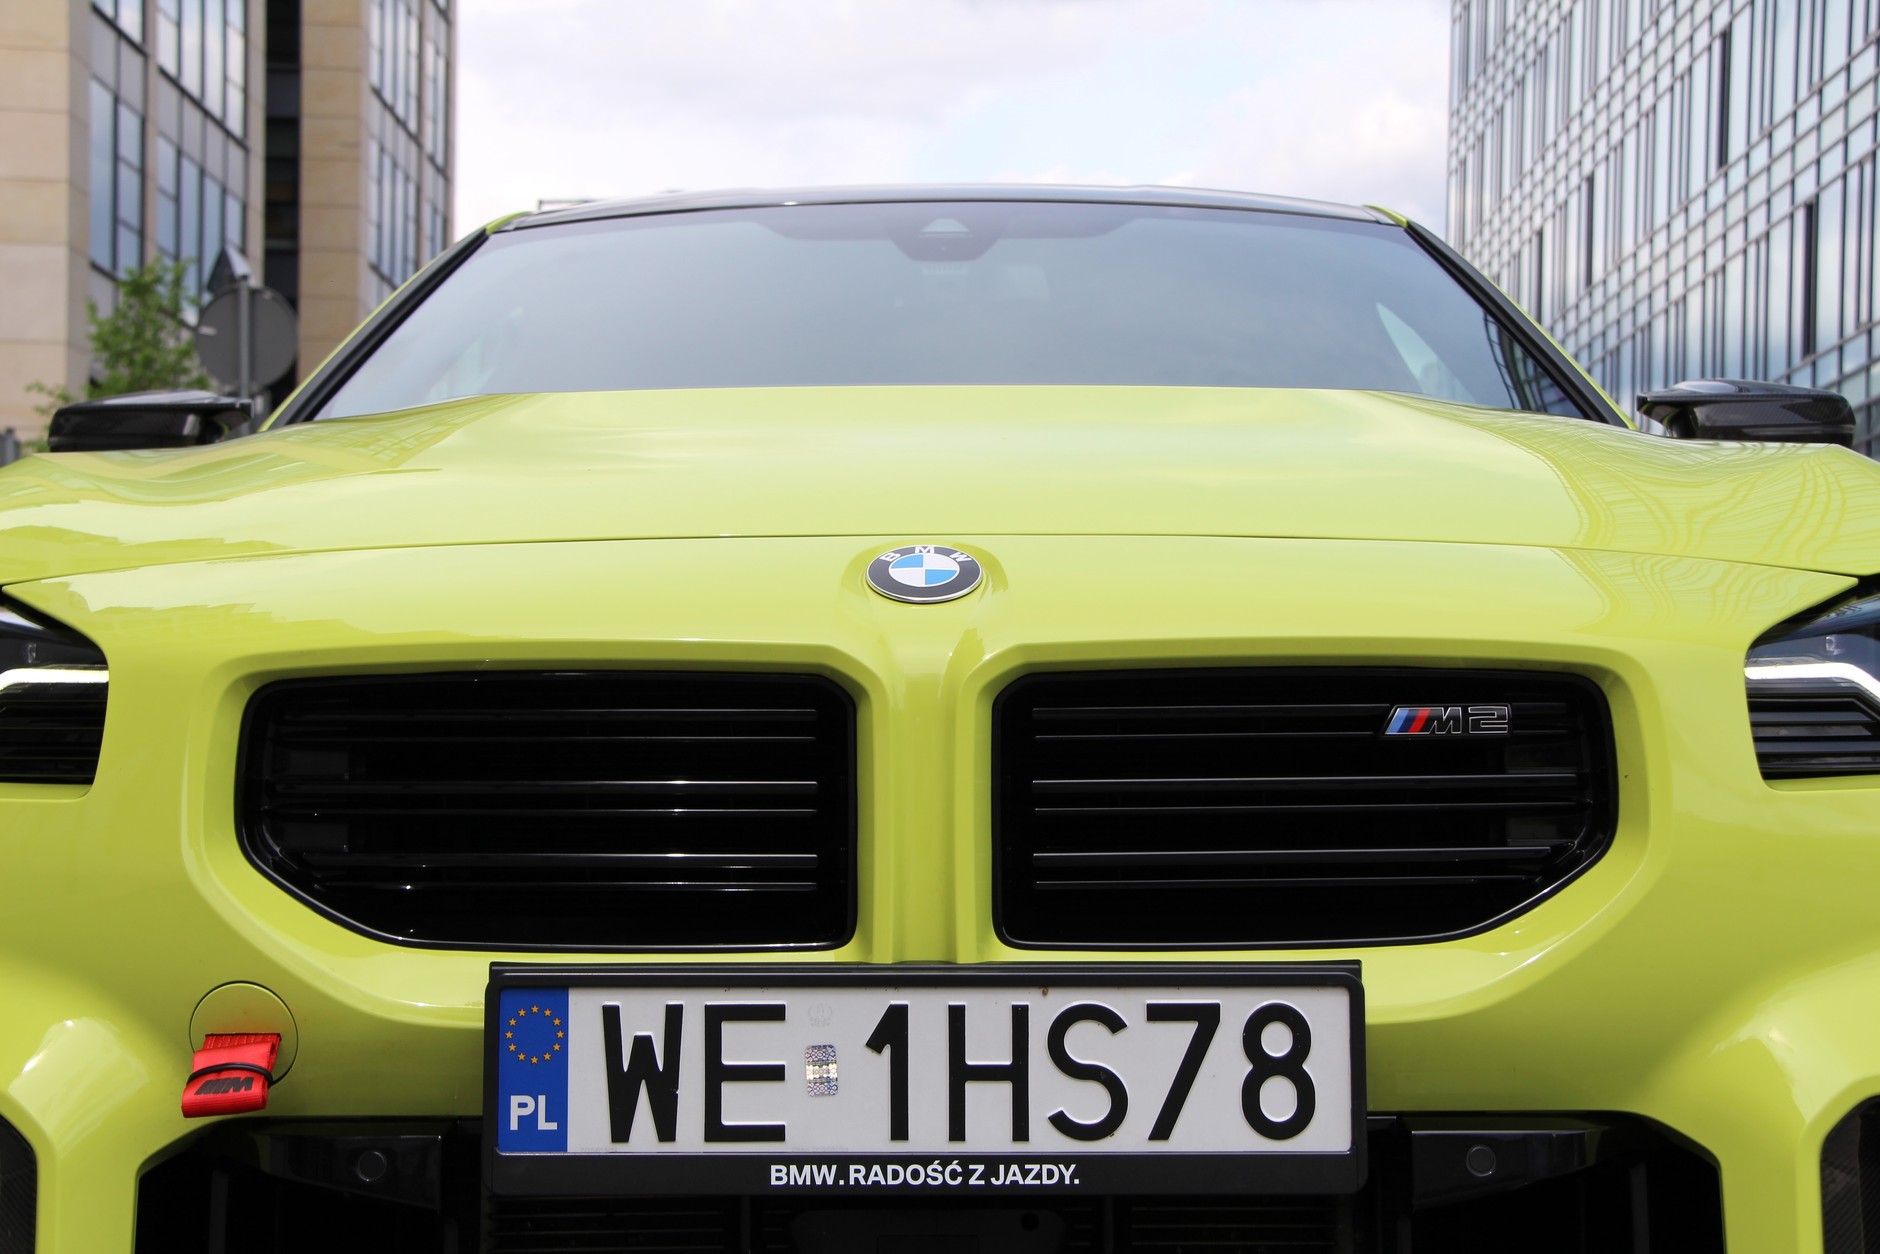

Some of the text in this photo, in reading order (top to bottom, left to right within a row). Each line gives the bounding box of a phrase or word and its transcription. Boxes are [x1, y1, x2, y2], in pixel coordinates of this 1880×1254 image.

[879, 546, 972, 562] BMW
[602, 1002, 1316, 1142] WE 1HS78
[510, 1095, 558, 1130] PL
[849, 1160, 963, 1186] RADOŚĆ
[968, 1164, 985, 1185] Z
[990, 1164, 1080, 1186] JAZDY.
